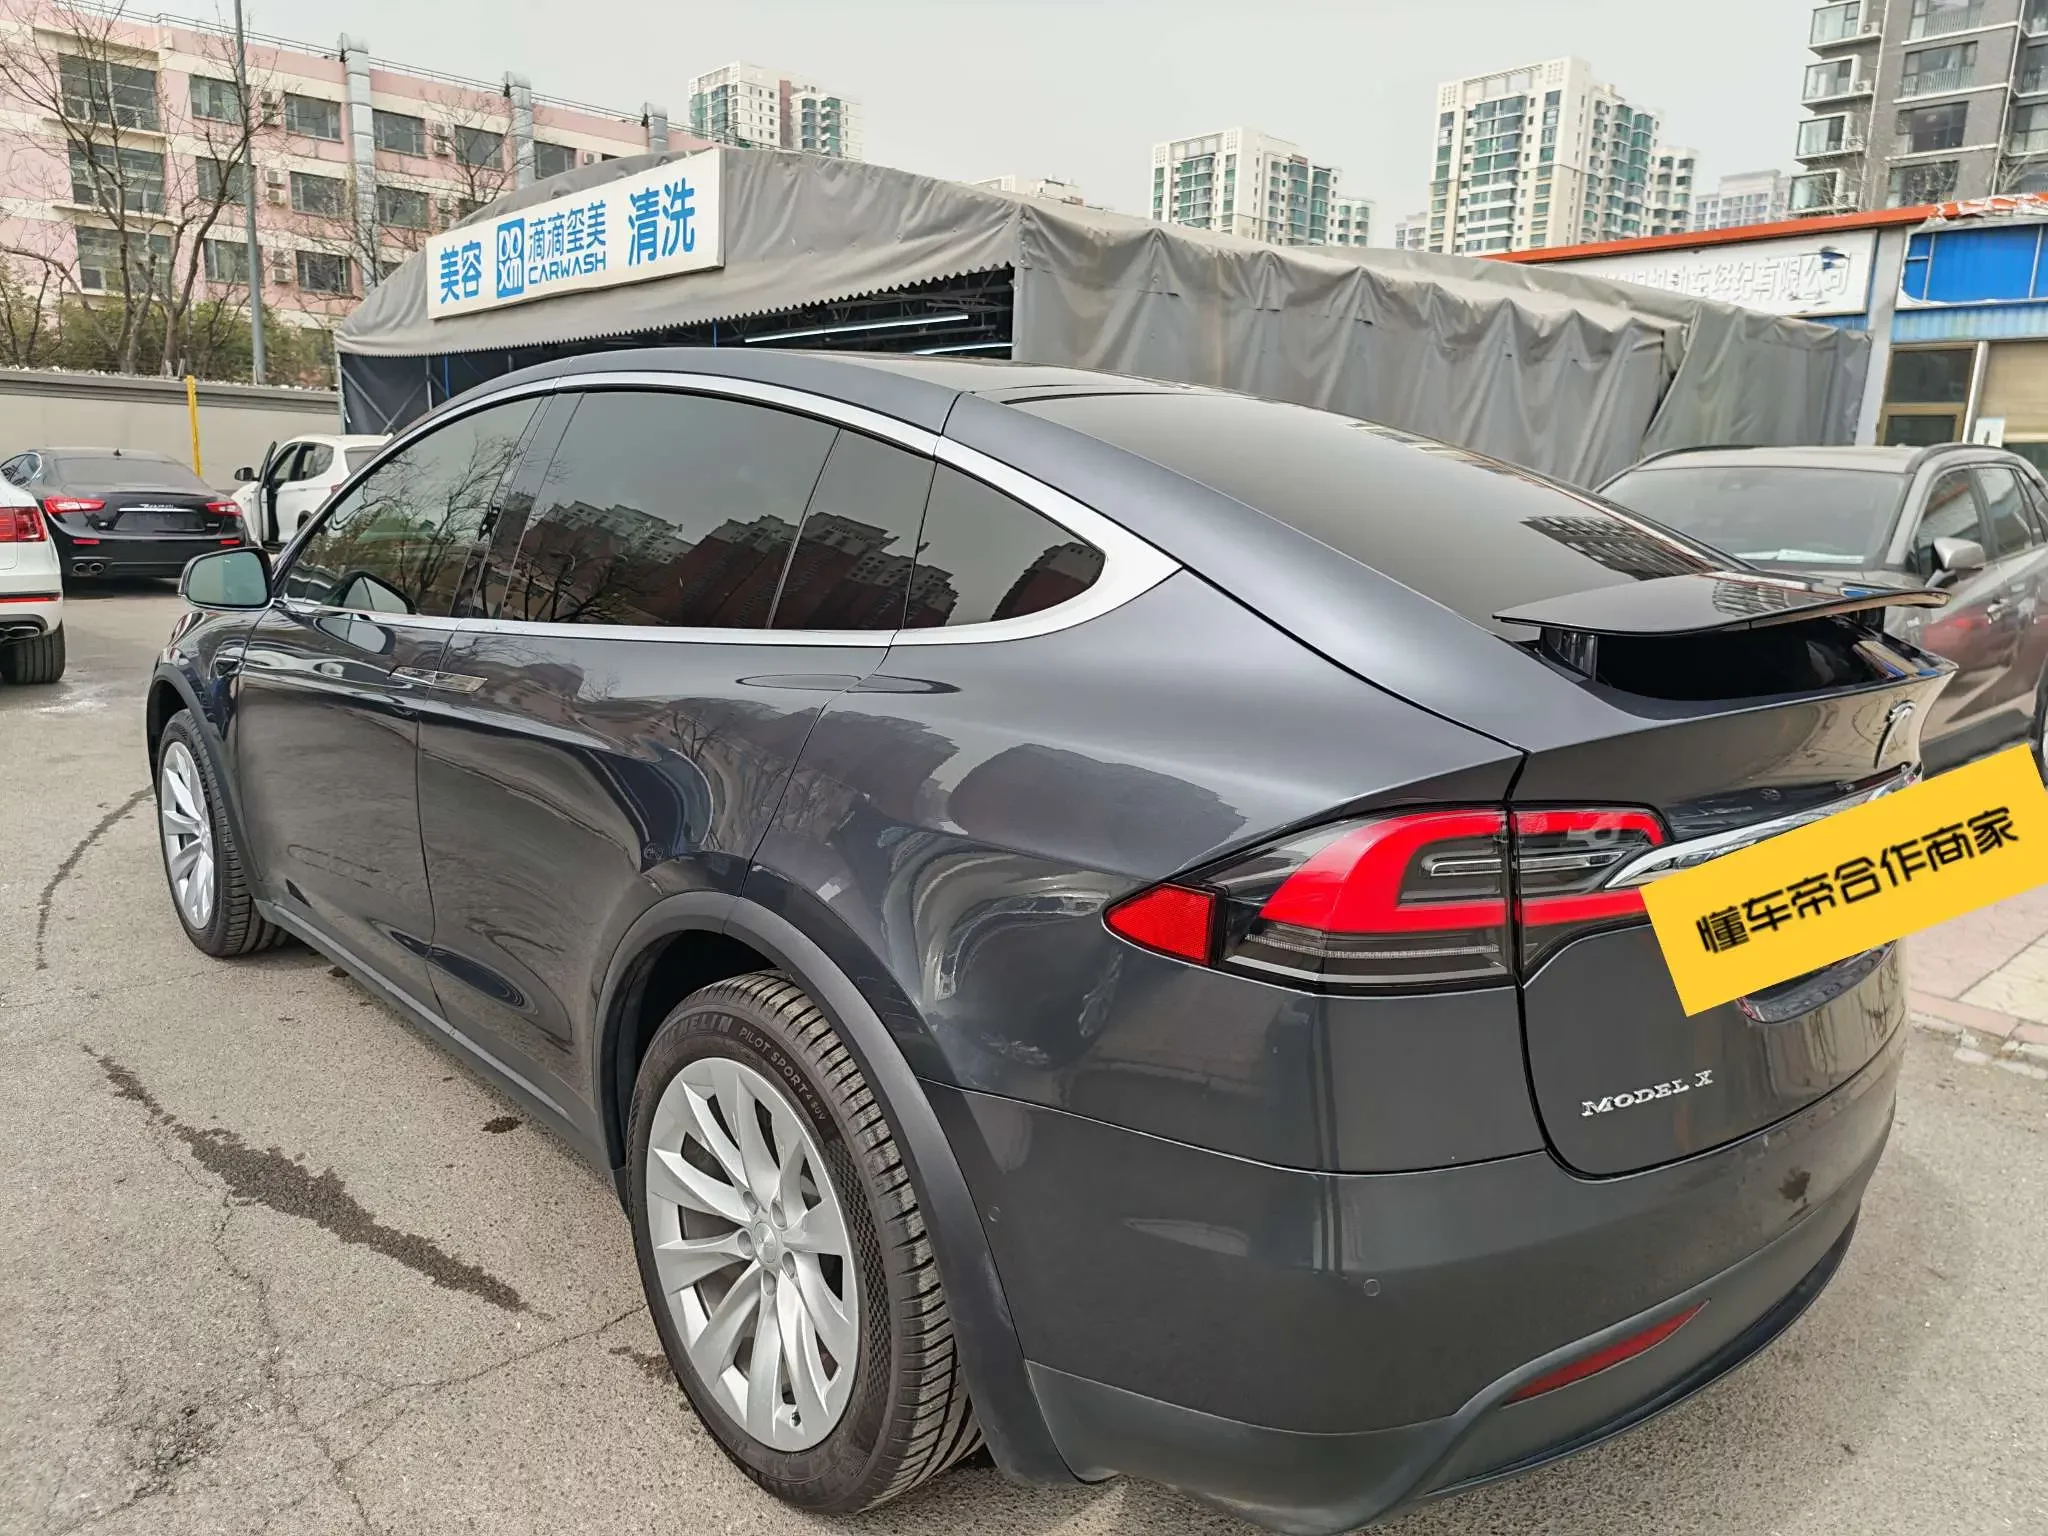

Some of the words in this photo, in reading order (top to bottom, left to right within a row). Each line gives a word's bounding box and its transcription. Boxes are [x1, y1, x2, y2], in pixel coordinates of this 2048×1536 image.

[528, 200, 607, 262] 滴滴玺美
[628, 178, 696, 265] 清洗
[440, 241, 482, 303] 美容
[528, 250, 607, 285] CARWASH
[739, 1026, 771, 1050] PILOT
[770, 1053, 809, 1094] SPORT
[1581, 1079, 1690, 1117] MODEL
[1694, 1069, 1714, 1088] X
